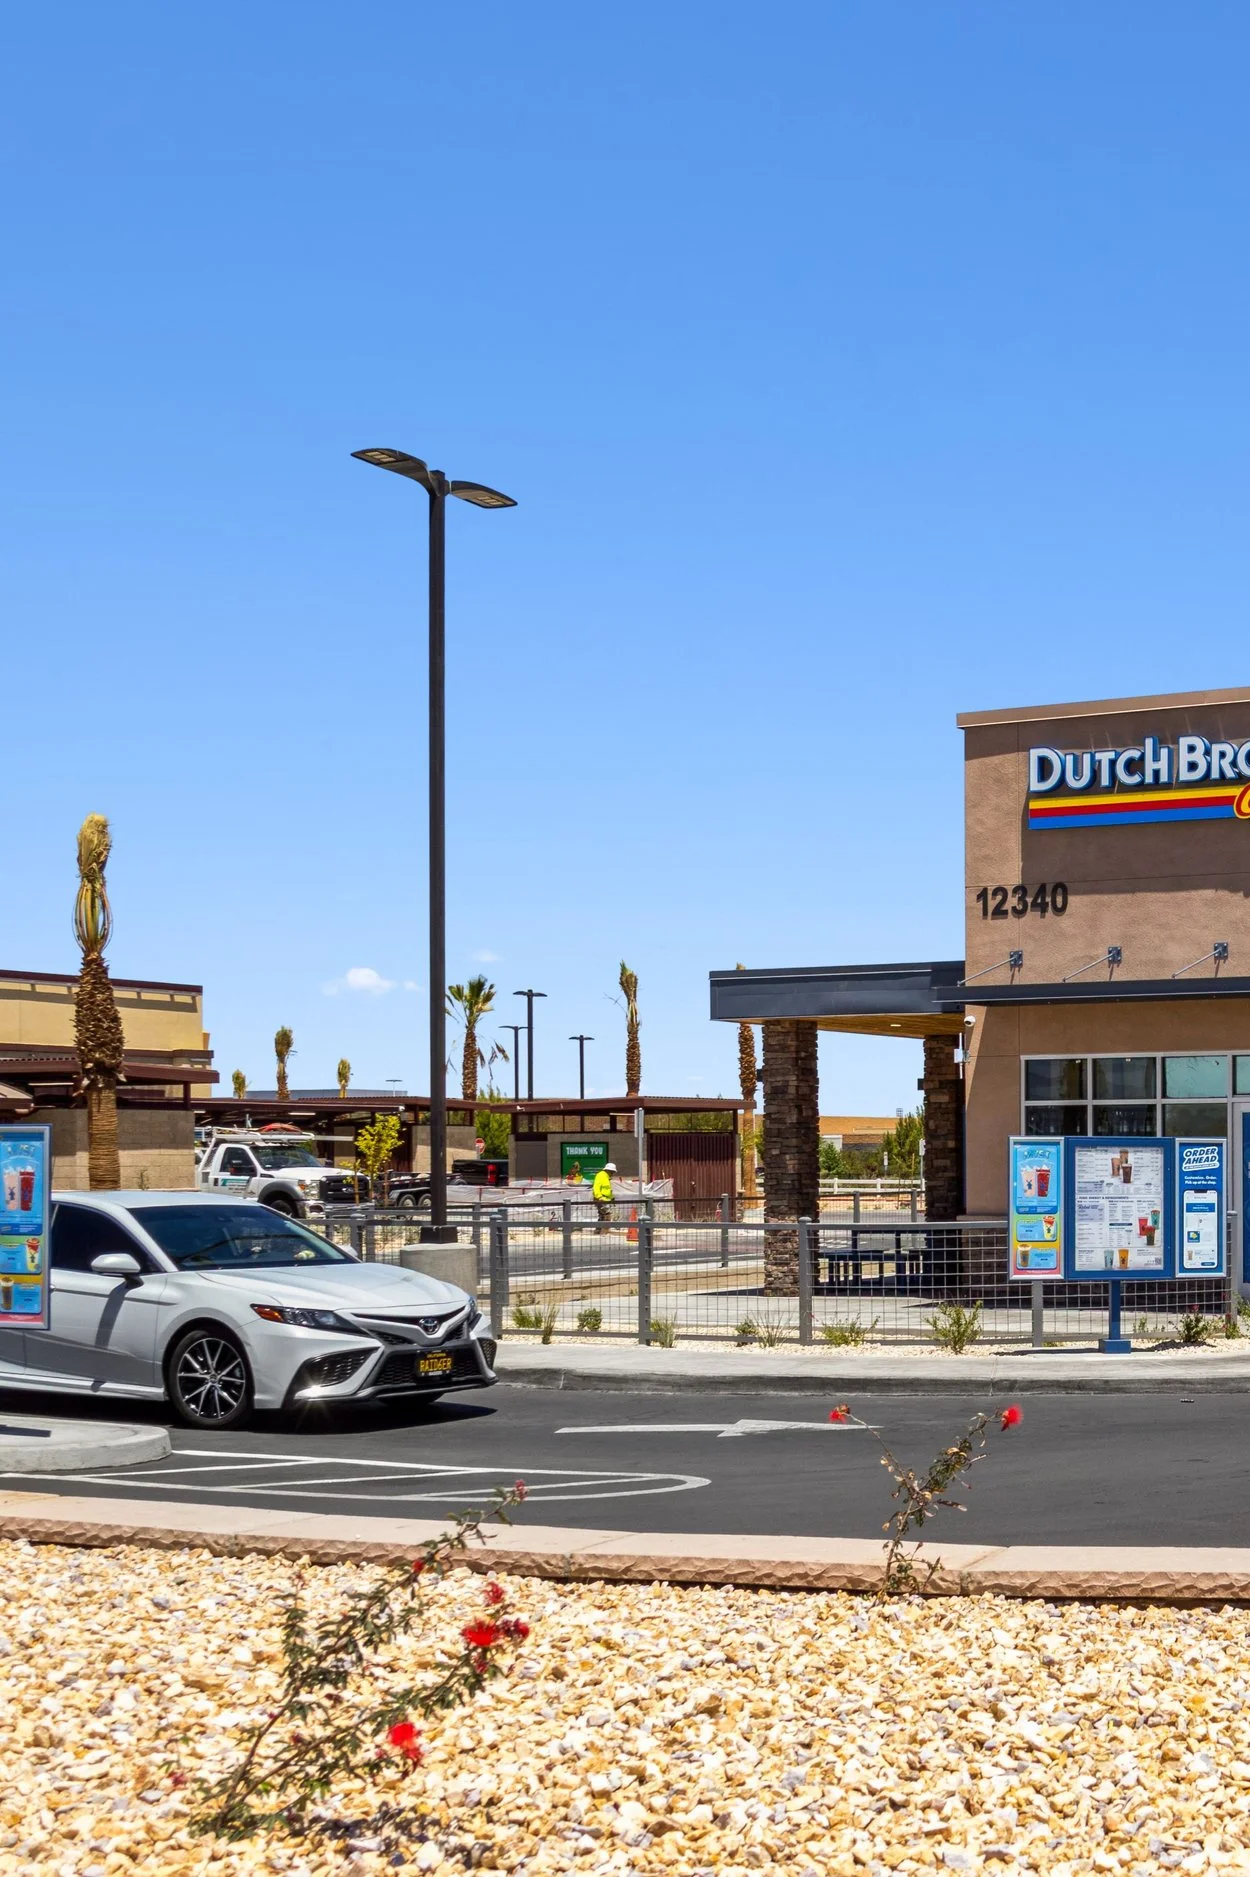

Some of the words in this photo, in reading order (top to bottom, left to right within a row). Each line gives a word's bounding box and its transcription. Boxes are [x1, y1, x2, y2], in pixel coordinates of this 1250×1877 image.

[1028, 736, 1174, 793] DUTCH
[976, 882, 1068, 917] 12340
[566, 1146, 588, 1155] THANK
[590, 1146, 603, 1155] YOU
[1185, 1148, 1217, 1158] ORDER
[1185, 1155, 1217, 1165] AHEAD
